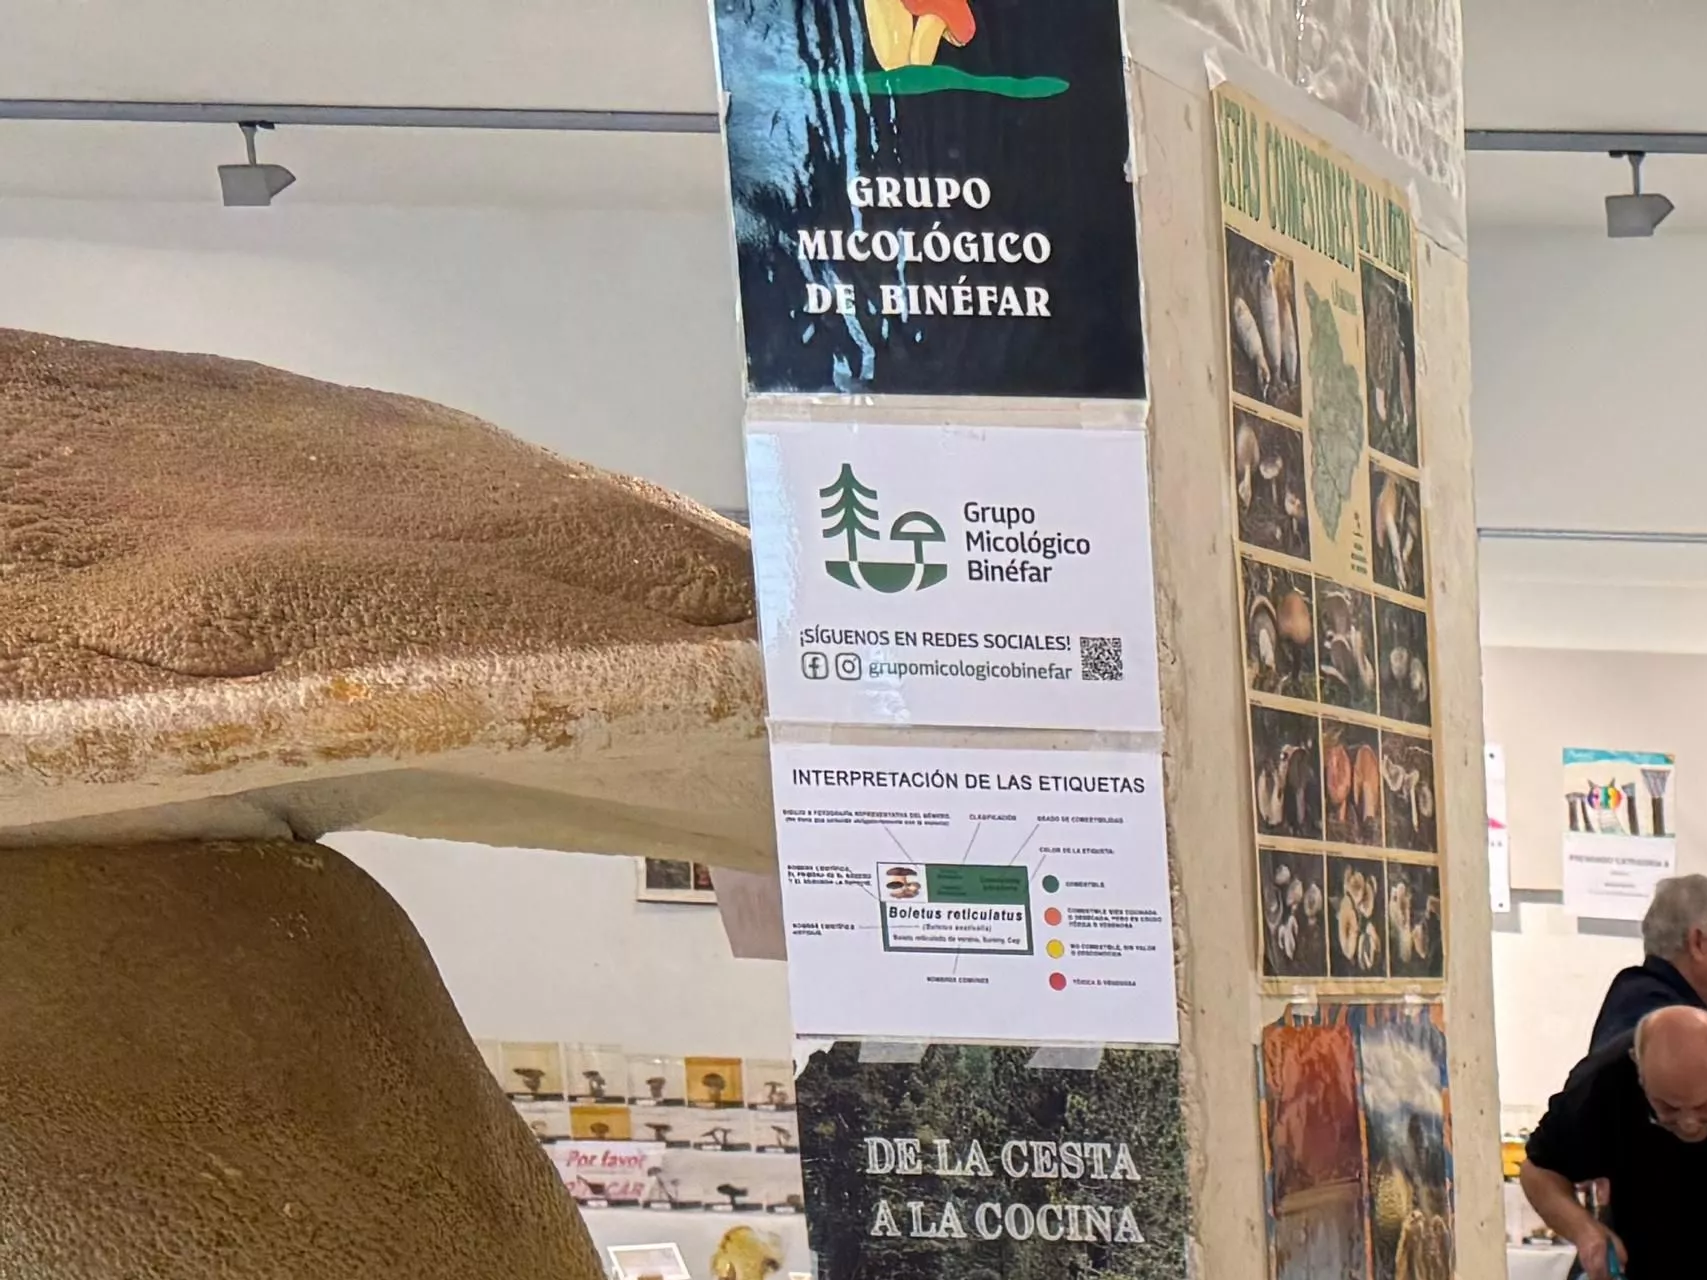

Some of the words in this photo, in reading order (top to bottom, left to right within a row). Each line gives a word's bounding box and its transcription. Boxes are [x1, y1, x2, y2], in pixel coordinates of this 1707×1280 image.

[850, 176, 991, 209] GRUPO
[798, 221, 1051, 264] MICOLÓGICO
[805, 283, 856, 315] DE
[880, 275, 1051, 317] BINÉFAR
[963, 502, 1035, 528] Grupo
[966, 531, 1090, 558] Micológico
[968, 559, 1053, 583] Binéfar
[800, 624, 890, 647] ¡SÍGUENOS
[895, 631, 918, 647] EN
[922, 632, 979, 649] REDES
[983, 634, 1072, 651] SOCIALES!
[868, 655, 1073, 681] grupomicologicobinefar
[792, 768, 959, 790] INTERPRETACIÓN
[965, 774, 990, 790] DE
[996, 774, 1032, 791] LAS
[1038, 776, 1145, 793] ETIQUETAS
[889, 906, 941, 920] Boletus
[946, 908, 1023, 922] reticulatus
[864, 1137, 922, 1175] DE
[933, 1138, 993, 1177] LA
[1001, 1140, 1141, 1180] CESTA
[870, 1200, 901, 1237] A
[907, 1201, 967, 1238] LA
[975, 1202, 1145, 1243] COCINA
